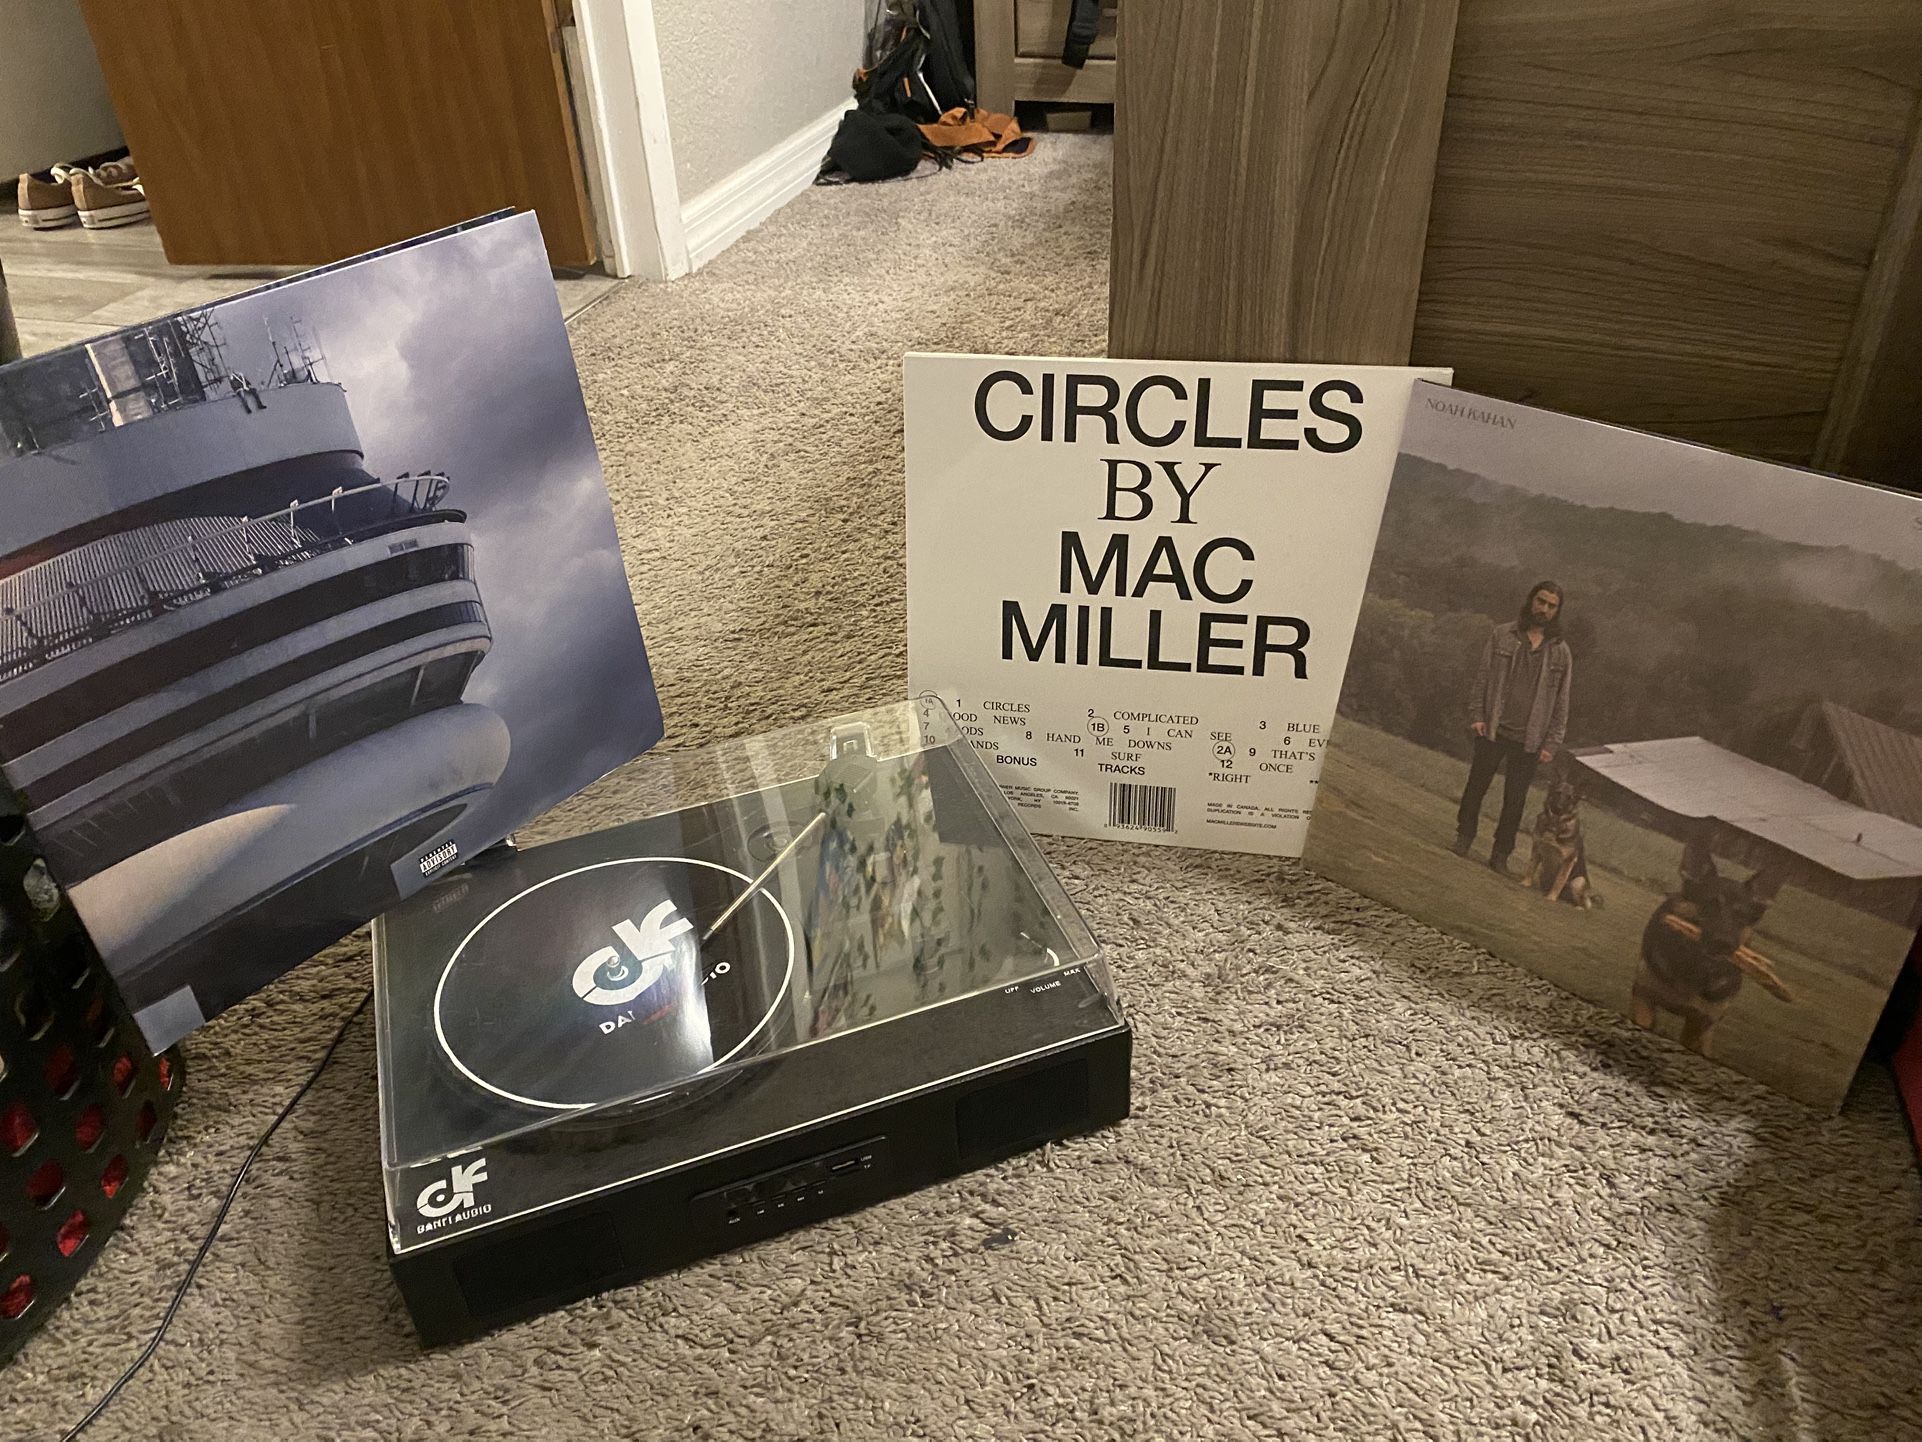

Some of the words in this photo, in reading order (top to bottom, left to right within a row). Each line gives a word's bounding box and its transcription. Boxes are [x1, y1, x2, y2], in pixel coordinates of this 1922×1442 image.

[973, 369, 1364, 454] CIRCLES
[1425, 398, 1466, 417] NOAH
[1467, 407, 1517, 430] KAHAN
[1097, 458, 1222, 525] BY
[1060, 531, 1256, 604] MAC
[1001, 600, 1312, 680] MILLER
[923, 709, 930, 718] 4
[953, 712, 978, 722] OOD
[993, 714, 1027, 727] NEWS
[1091, 722, 1105, 732] 1B
[1123, 725, 1130, 734] 5
[1146, 727, 1151, 736] I
[1167, 728, 1194, 739] CAN
[1209, 731, 1232, 742] SEE
[1283, 736, 1291, 746] 6
[956, 698, 962, 708] 1
[982, 700, 1031, 713] CIRCLES
[1087, 708, 1095, 718] 2
[1113, 710, 1199, 726] COMPLICATED
[1258, 720, 1267, 730] 3
[1287, 722, 1320, 734] BLUE
[923, 722, 930, 730] 7
[1025, 730, 1033, 740] 8
[1046, 732, 1082, 744] HAND
[1095, 736, 1114, 747] ME
[1128, 738, 1172, 751] DOWNS
[1216, 745, 1233, 755] 2A
[1248, 747, 1257, 757] 9
[1271, 749, 1316, 762] THAT'S
[923, 735, 936, 745] 10
[1073, 748, 1085, 758] 11
[1111, 751, 1143, 763] SURF
[1220, 759, 1233, 769] 12
[1259, 761, 1294, 774] ONCE
[996, 754, 1038, 767] BONUS
[1098, 763, 1146, 776] TRACKS
[422, 845, 456, 872] ADVISORY
[1030, 980, 1061, 994] VOLUME
[454, 1203, 492, 1223] AUDIO
